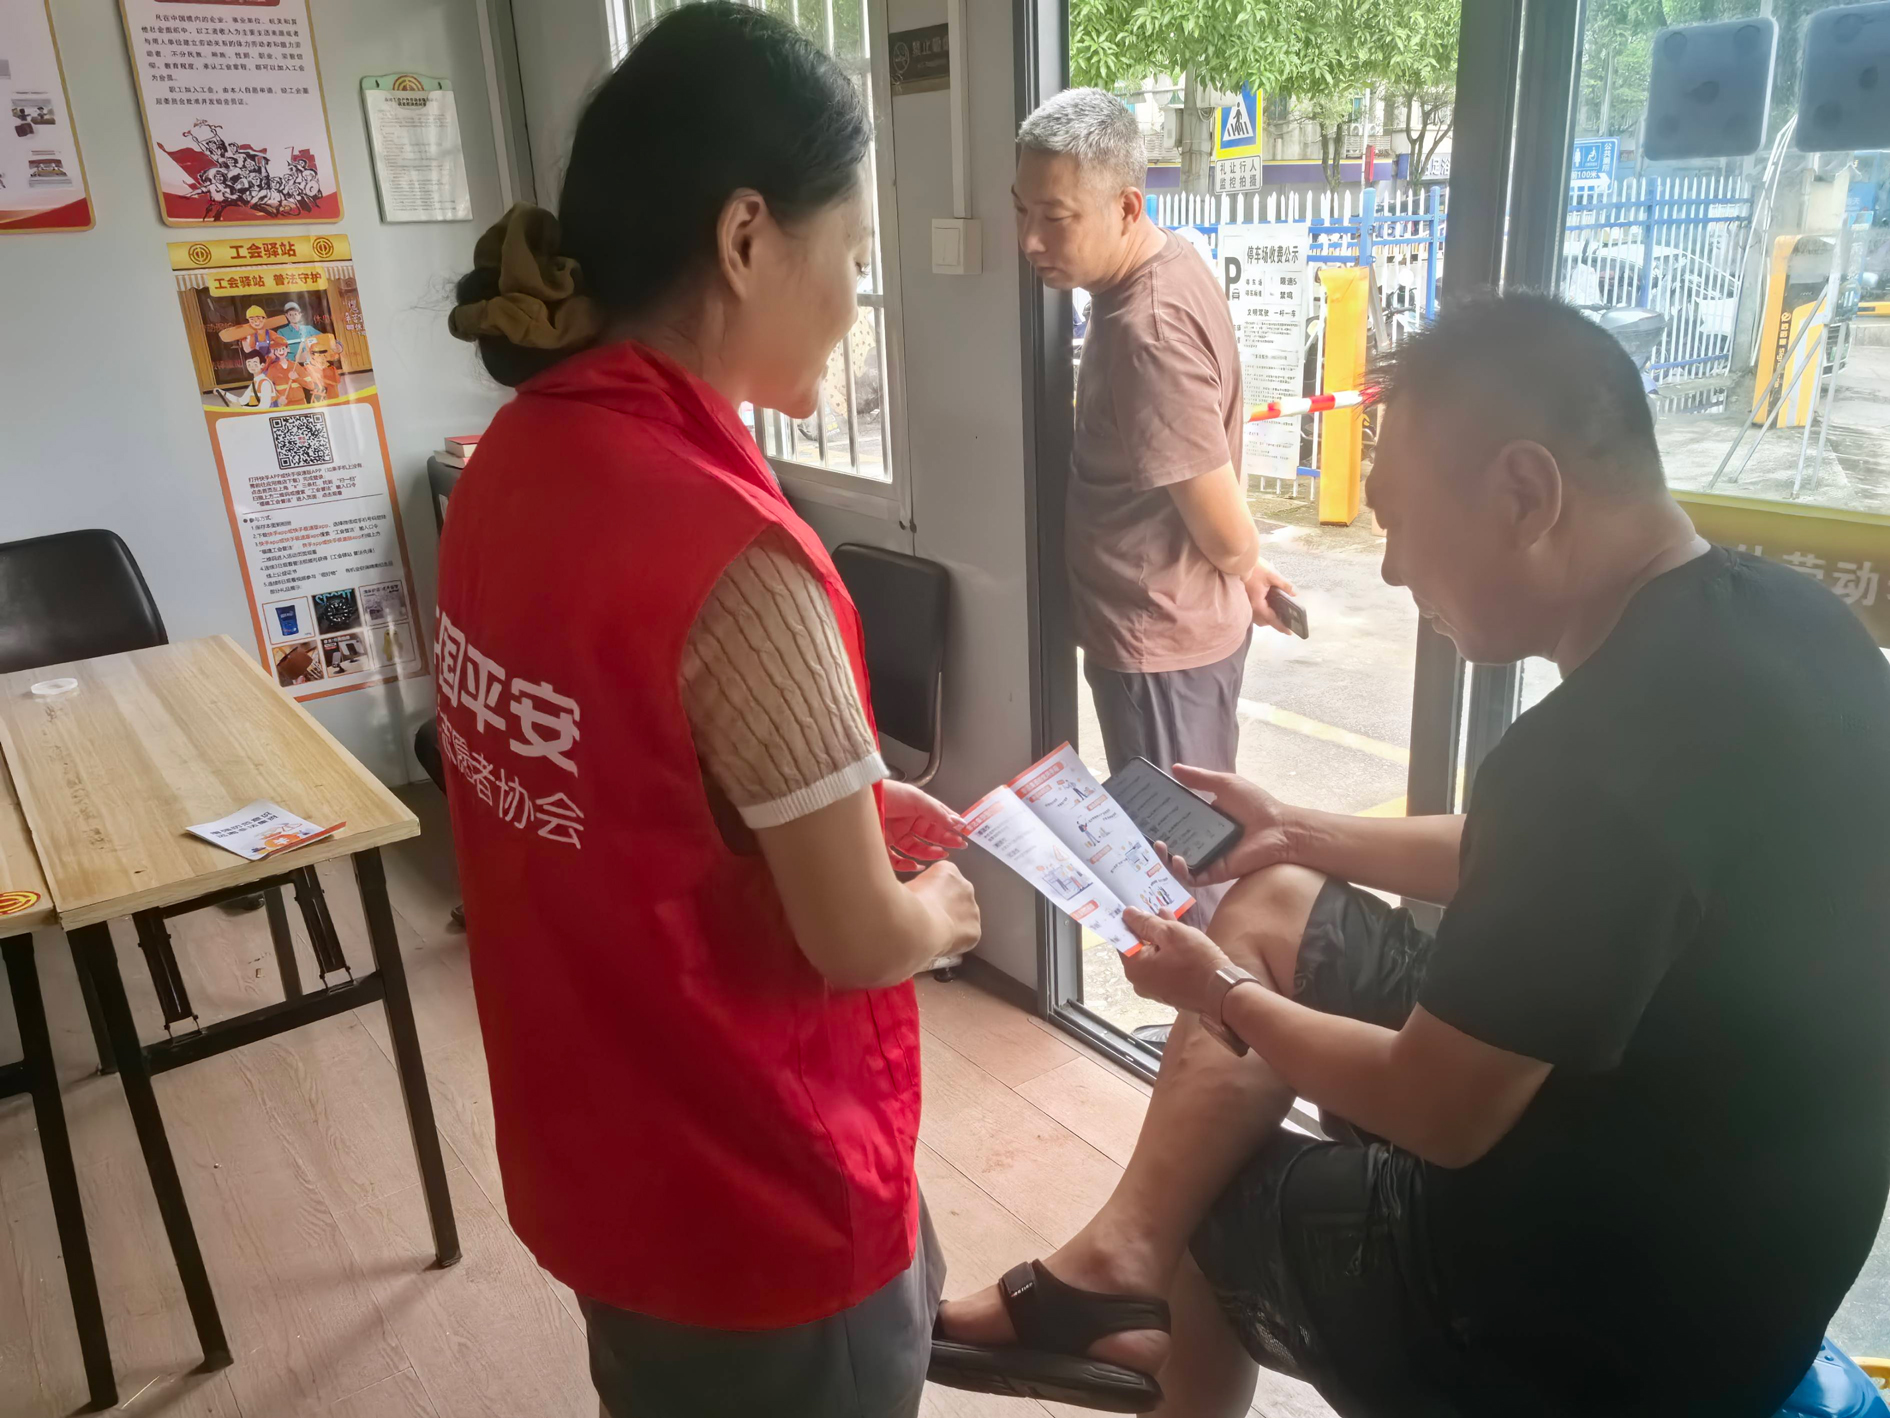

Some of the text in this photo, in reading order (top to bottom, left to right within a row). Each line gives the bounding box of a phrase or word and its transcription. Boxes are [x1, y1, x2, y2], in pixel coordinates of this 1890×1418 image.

[1220, 160, 1257, 175] 礼让行人
[1220, 174, 1257, 190] 监控拍摄
[229, 241, 297, 260] 工会驿站
[1247, 246, 1299, 264] 停车场收费公示
[214, 271, 322, 289] 工会驿站 普法守护
[1225, 257, 1242, 301] P
[1280, 277, 1297, 286] 限速5
[1247, 308, 1269, 317] 文明驾驶
[434, 605, 580, 778] 国平安
[436, 693, 584, 850] 志愿者协会
